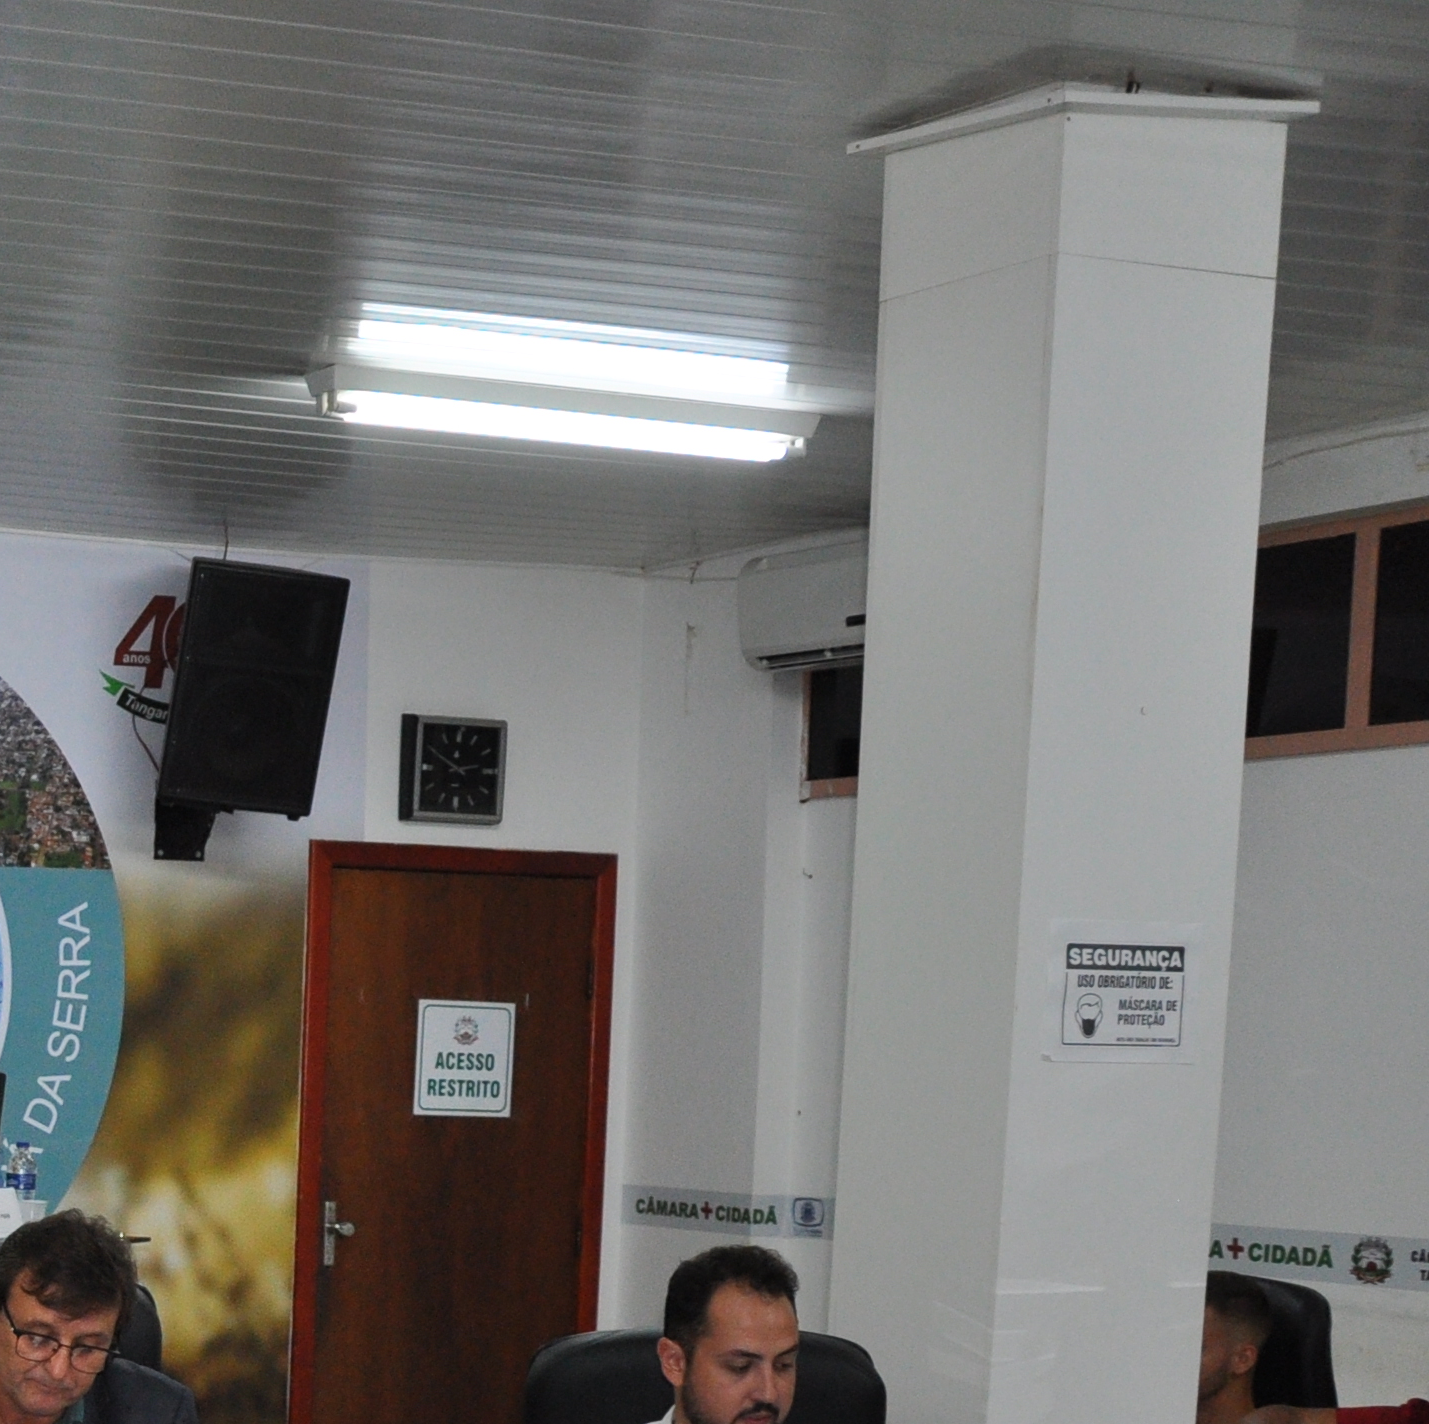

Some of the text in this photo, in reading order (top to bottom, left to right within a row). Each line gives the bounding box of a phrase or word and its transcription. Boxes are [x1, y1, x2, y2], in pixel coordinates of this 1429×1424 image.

[123, 654, 151, 664] anos
[126, 694, 168, 719] Tangar
[1069, 947, 1182, 971] SEGURANÇA
[1078, 972, 1173, 989] USO OBRIGATÓRIO DE:
[1119, 996, 1177, 1011] MÁSCARA DE
[23, 901, 91, 1134] DA SERRA
[1117, 1012, 1165, 1029] PROTEÇÃO
[435, 1052, 494, 1071] ACESSO
[427, 1079, 500, 1098] RESTRITO
